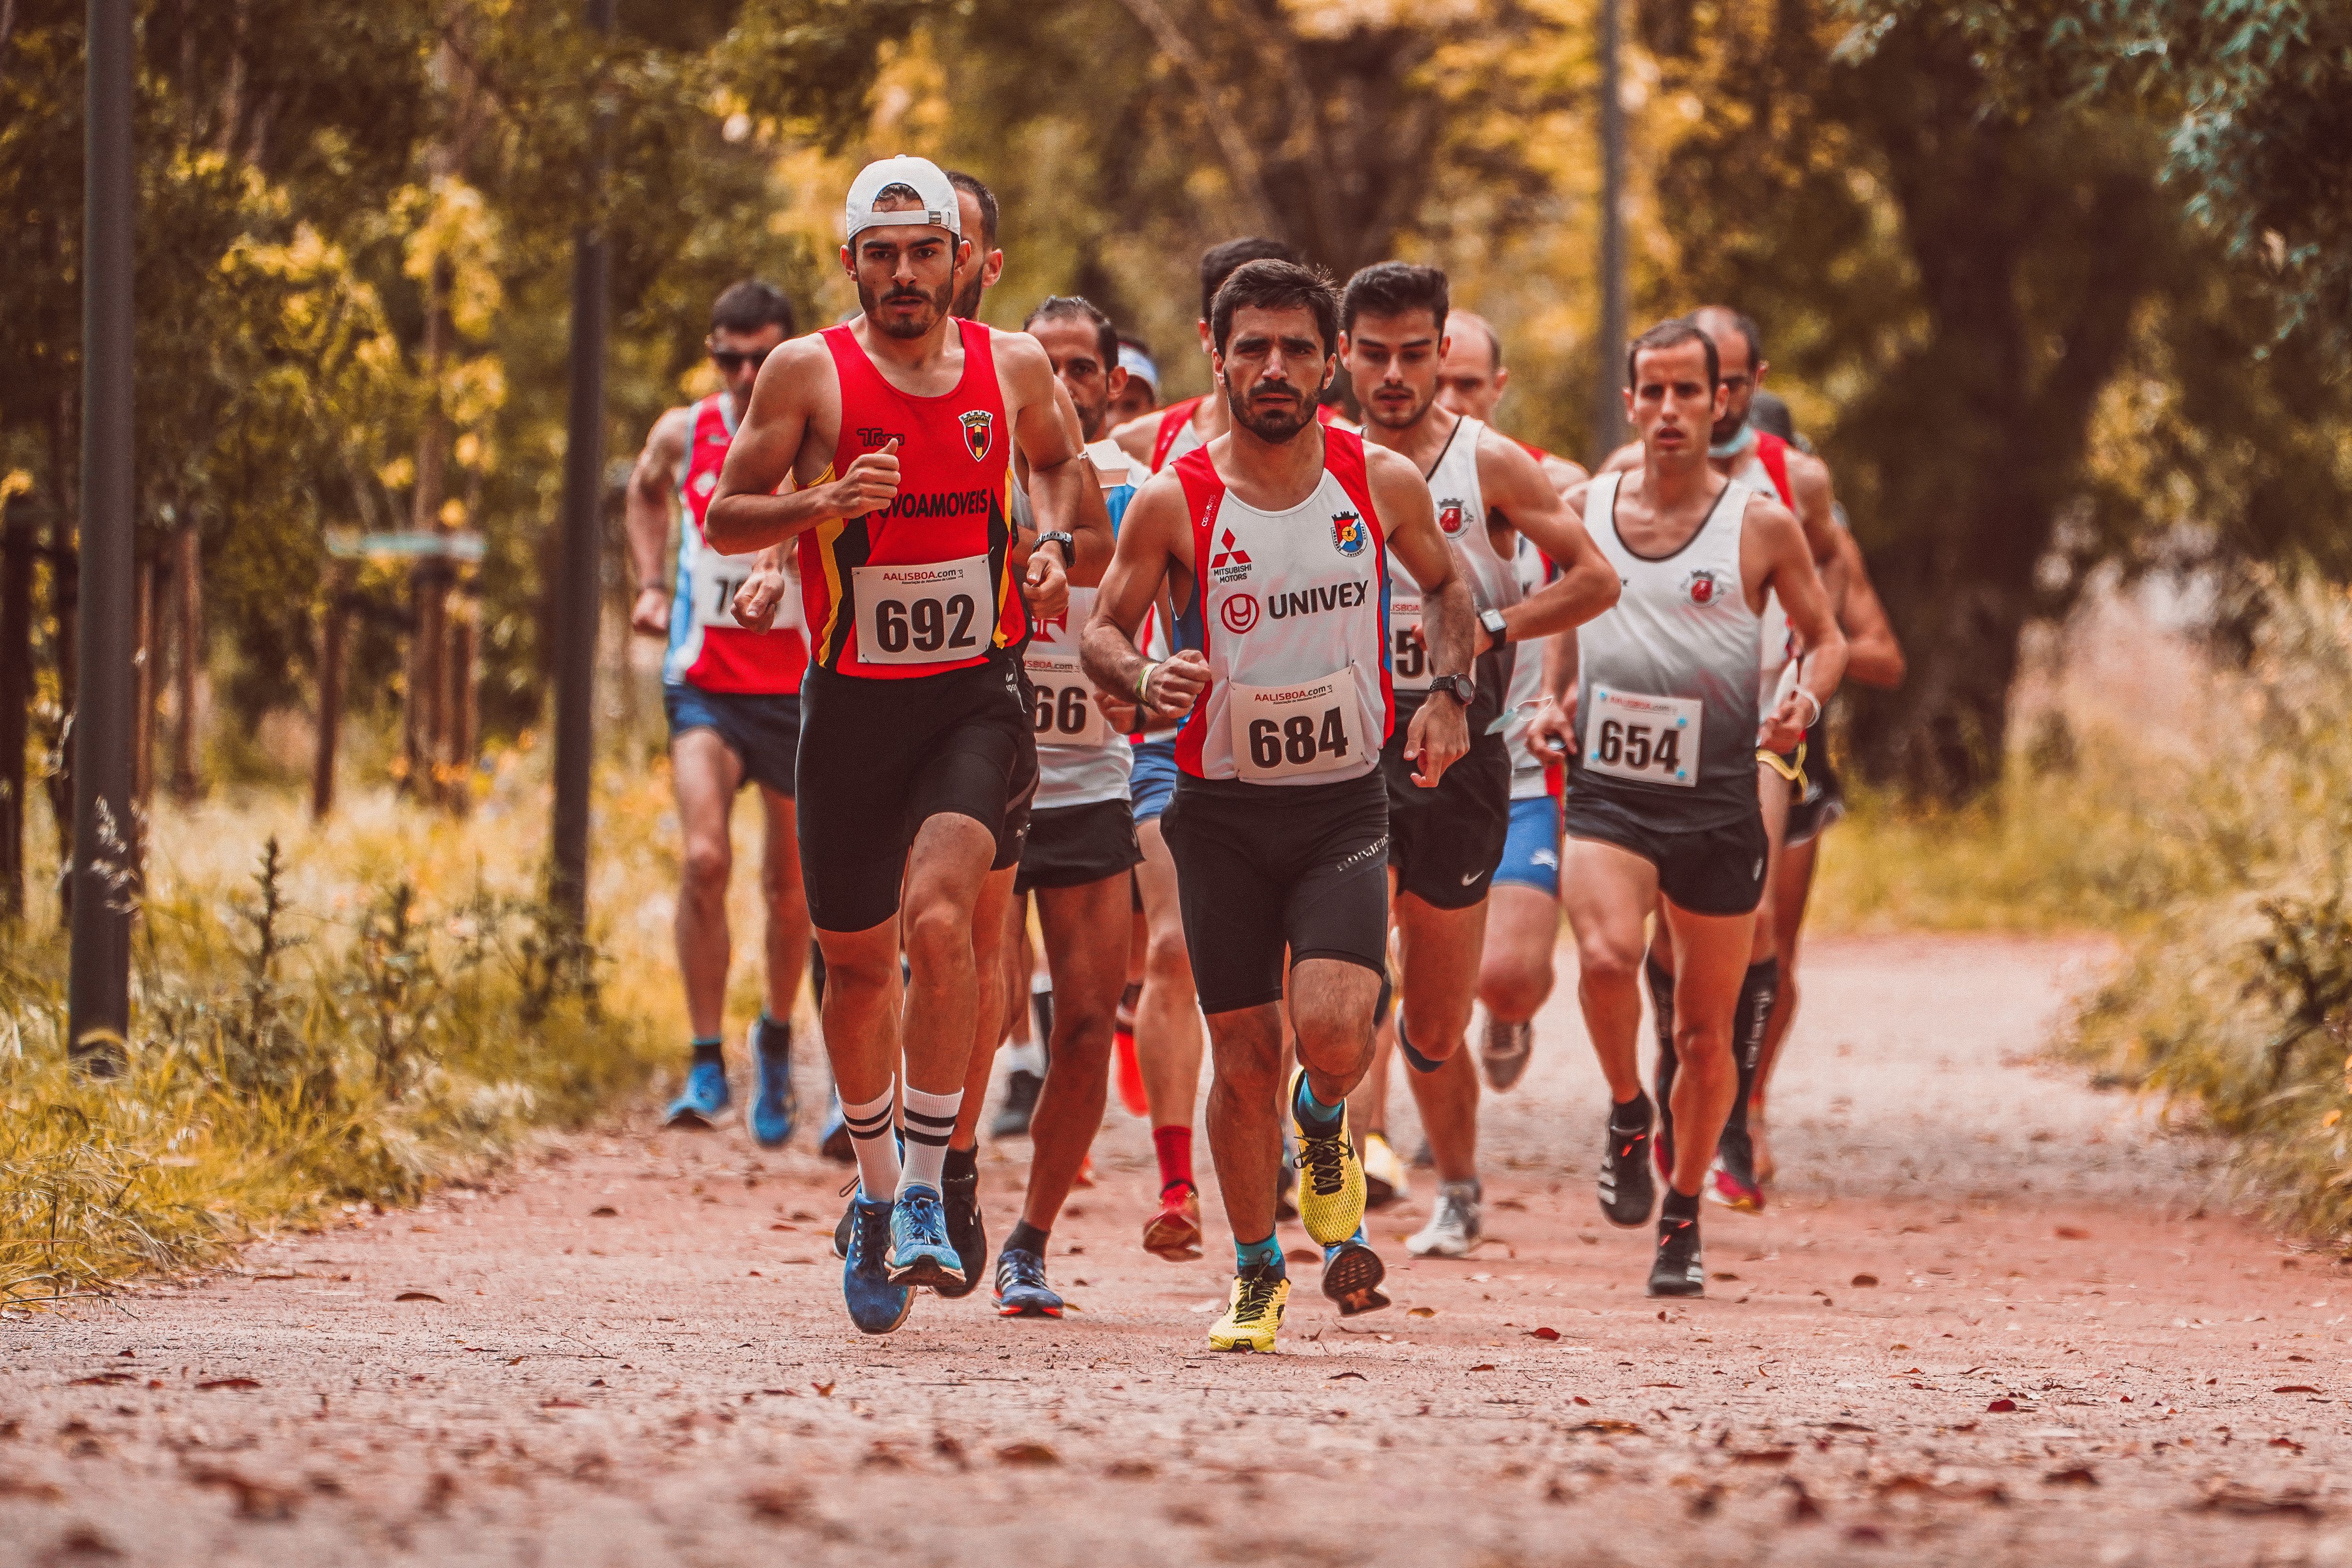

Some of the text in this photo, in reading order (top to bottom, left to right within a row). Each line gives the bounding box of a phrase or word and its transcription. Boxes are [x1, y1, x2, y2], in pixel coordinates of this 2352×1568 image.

[867, 488, 988, 518] VOAMOVEIS
[883, 569, 956, 581] AALISBOA.com
[1213, 564, 1252, 576] MITSUBISHI
[1220, 573, 1247, 583] MOTORS
[1268, 579, 1369, 620] UNIVEX
[875, 594, 976, 653] 692
[1035, 685, 1088, 735] 66
[1254, 686, 1326, 701] AALISBOA.com
[1249, 706, 1348, 769] 684
[1601, 720, 1680, 774] 654
